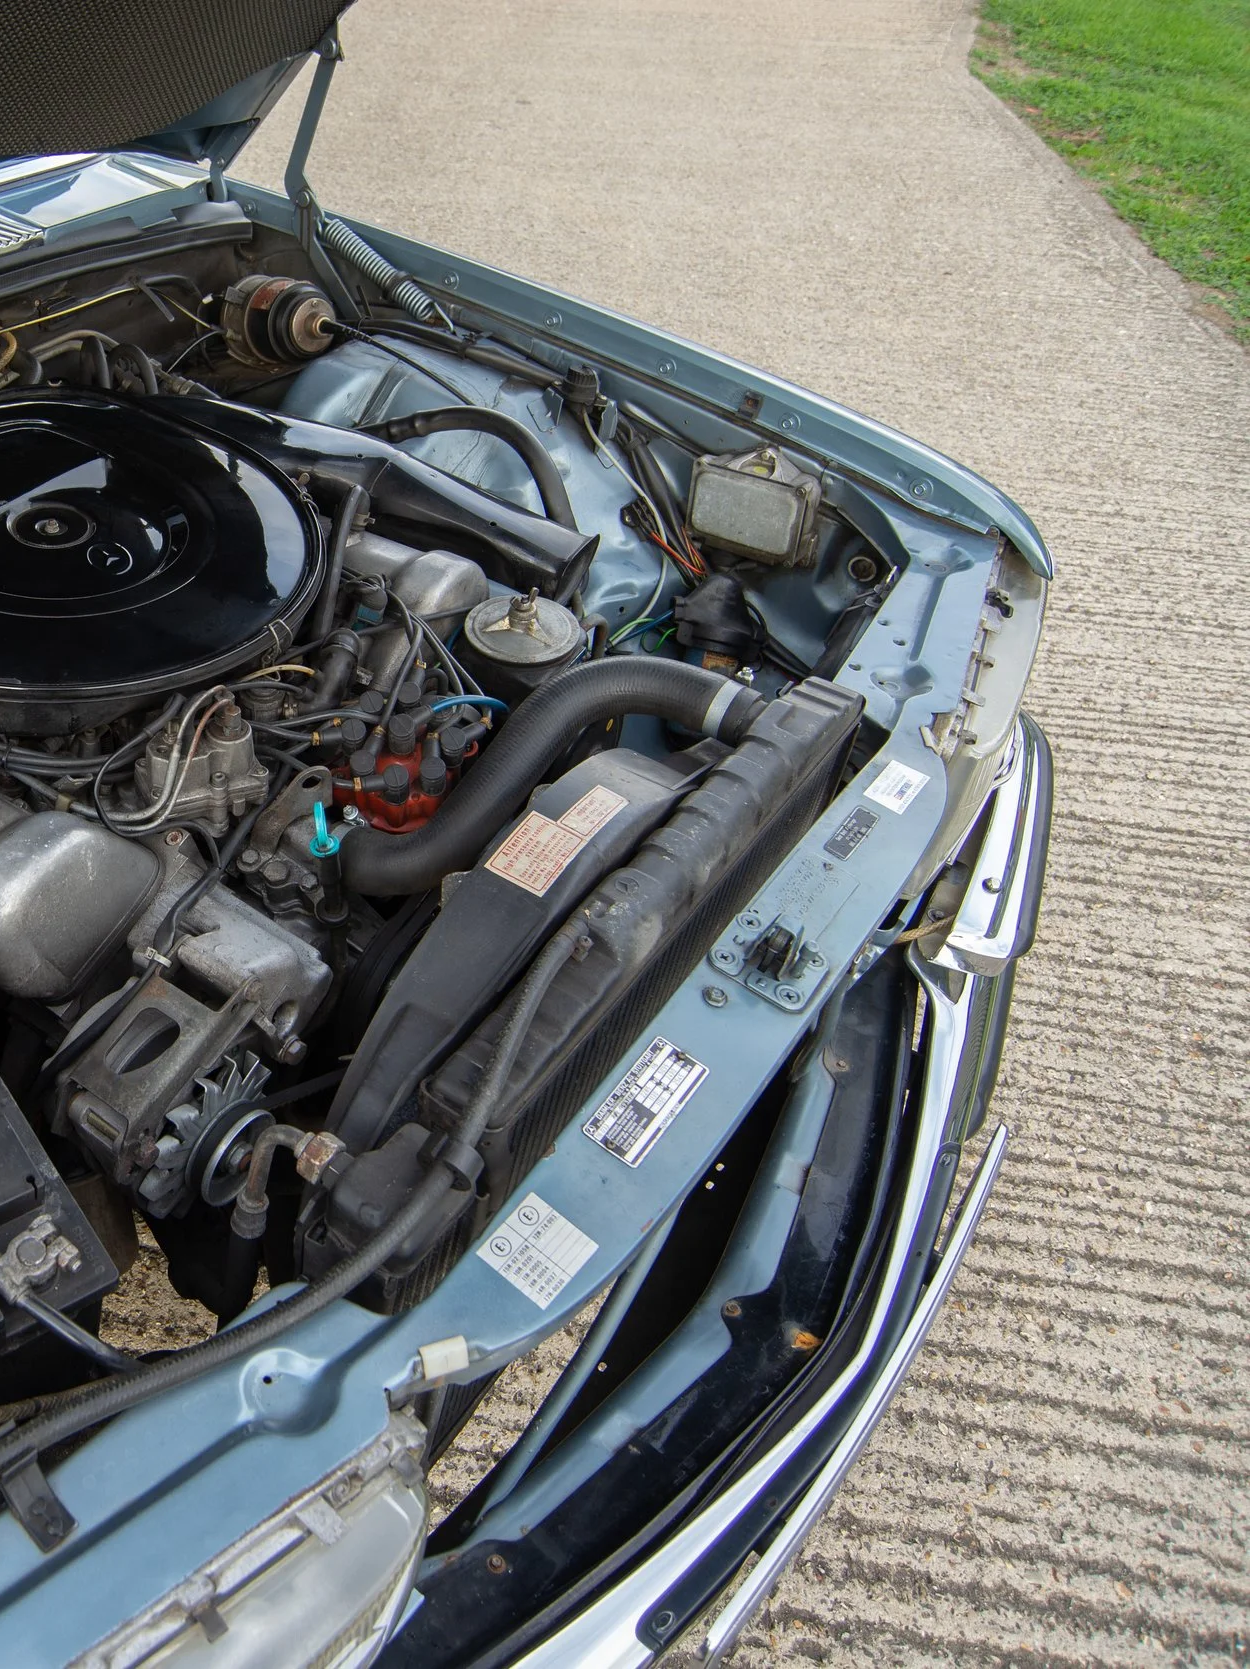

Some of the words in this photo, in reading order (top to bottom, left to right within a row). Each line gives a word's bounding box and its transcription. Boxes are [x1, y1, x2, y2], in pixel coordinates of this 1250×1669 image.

[502, 823, 532, 857] Attention!
[512, 835, 534, 860] pressure
[531, 820, 549, 837] cooling
[525, 839, 541, 857] system
[632, 1049, 654, 1074] STUTTGART
